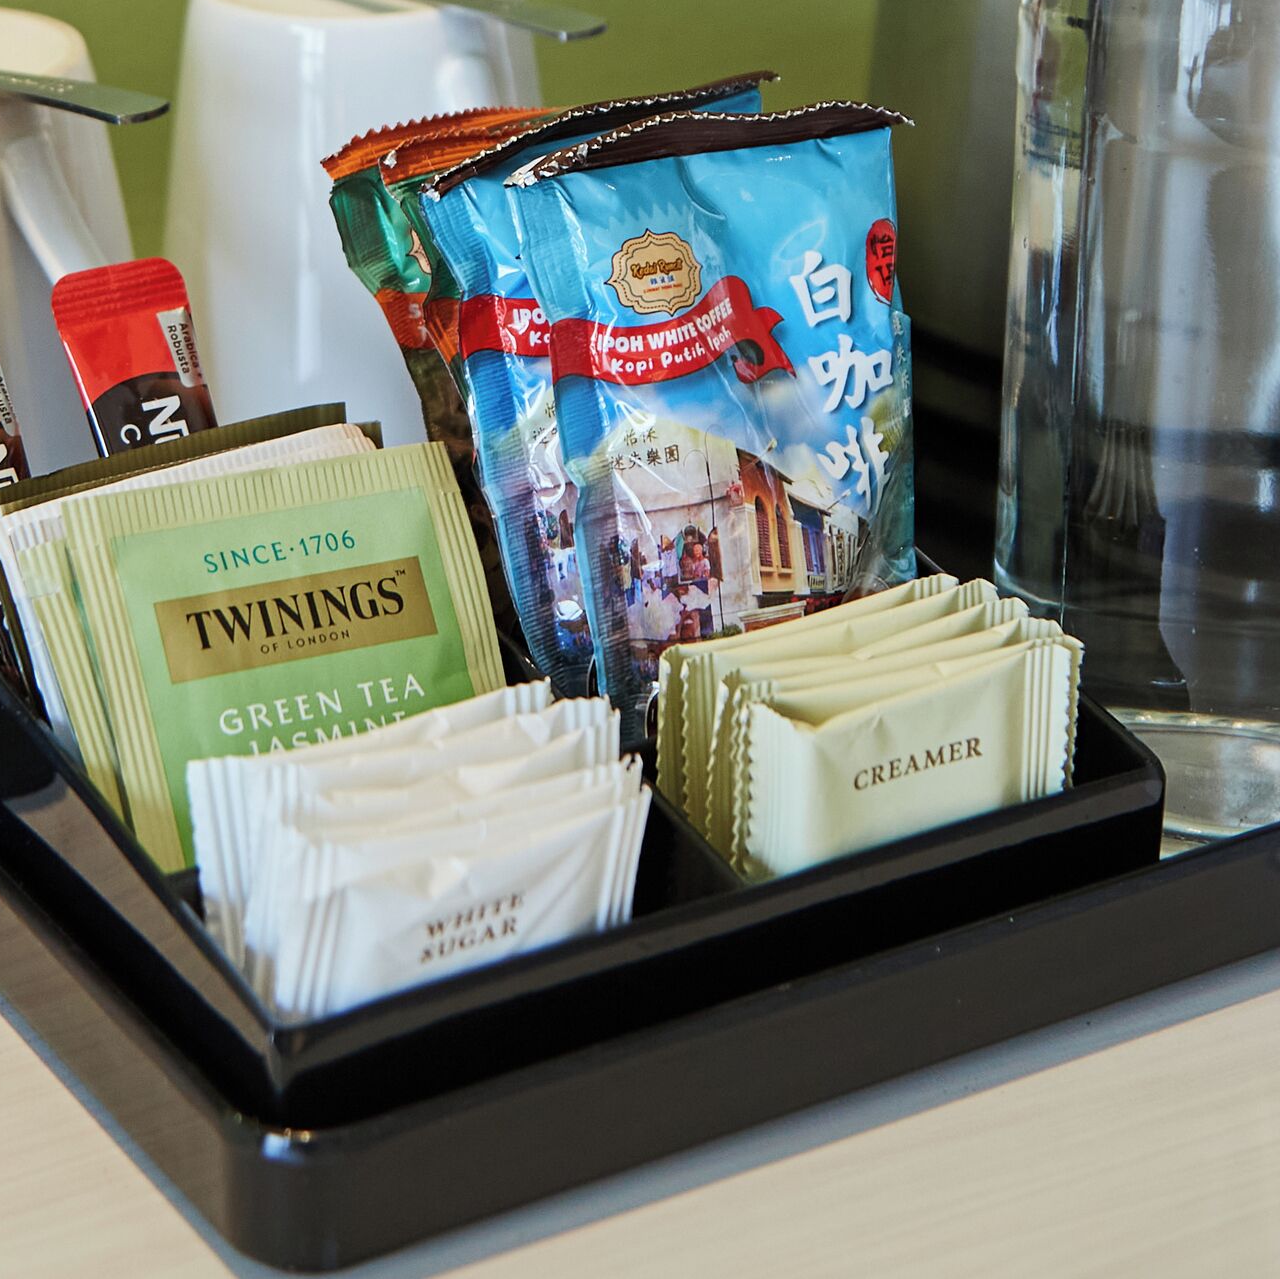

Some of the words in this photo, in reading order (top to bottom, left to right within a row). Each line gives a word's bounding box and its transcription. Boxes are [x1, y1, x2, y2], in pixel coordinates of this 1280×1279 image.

[512, 308, 549, 328] IPO
[597, 333, 644, 354] IPOH
[646, 322, 697, 350] WHITE
[696, 297, 733, 333] COFFEE
[168, 325, 190, 373] Robusta
[179, 323, 199, 368] Arabica
[611, 358, 653, 376] Kopi
[661, 342, 705, 368] Putih
[707, 325, 731, 351] Ipoh
[789, 250, 893, 516] 白咖啡
[260, 642, 279, 654] OF
[287, 629, 350, 650] LONDON
[219, 687, 344, 736] GREEN
[356, 673, 426, 707] TEA
[853, 737, 983, 791] CREAMER
[426, 893, 524, 938] WHITE
[421, 917, 517, 963] SUGAR
